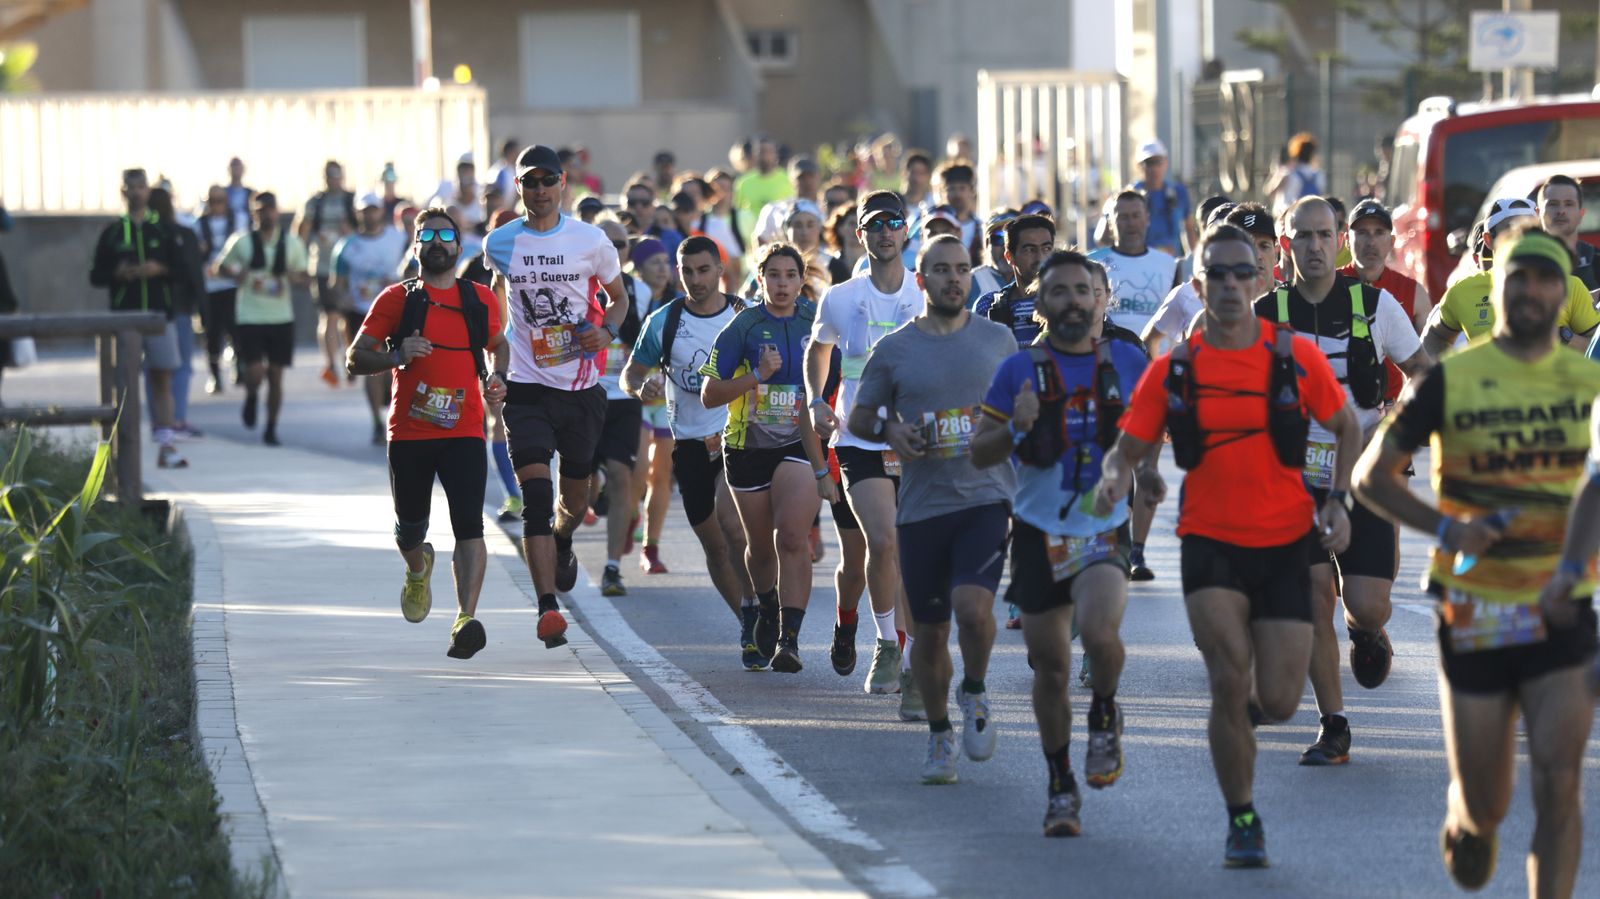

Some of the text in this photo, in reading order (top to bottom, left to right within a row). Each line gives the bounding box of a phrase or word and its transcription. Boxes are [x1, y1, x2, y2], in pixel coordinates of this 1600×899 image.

[523, 255, 564, 266] VI Trail
[509, 271, 580, 284] Las 3 Cuevas
[545, 329, 572, 348] 539
[427, 392, 452, 410] 267
[769, 391, 796, 406] 608
[939, 415, 973, 437] 286
[1490, 427, 1566, 450] TUS
[1305, 447, 1336, 468] 540
